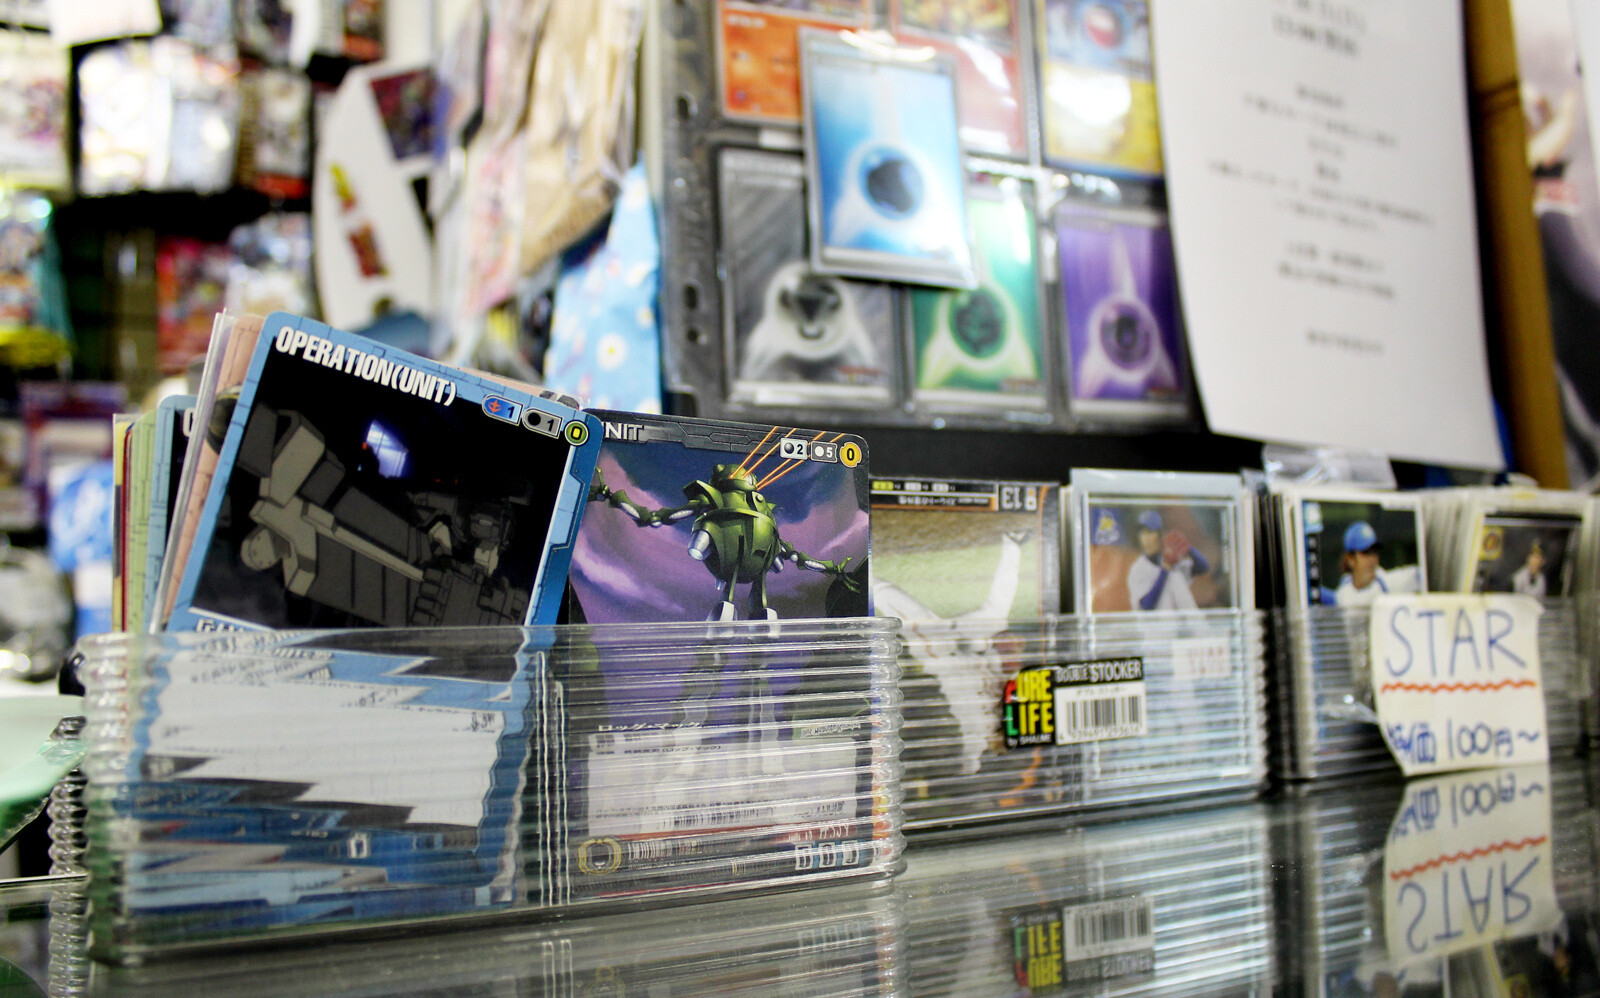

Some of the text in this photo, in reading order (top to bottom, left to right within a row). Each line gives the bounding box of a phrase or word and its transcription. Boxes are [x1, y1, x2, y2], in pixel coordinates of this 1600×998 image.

[275, 325, 457, 407] OPERATION(UNIT)
[506, 405, 515, 419] 1
[546, 418, 555, 432] 1
[603, 421, 645, 442] NIT
[796, 443, 804, 455] 2
[826, 446, 833, 458] 5
[847, 448, 854, 462] 0
[1385, 605, 1527, 677] STAR
[1089, 660, 1143, 682] STOCKER
[1005, 702, 1054, 736] LIFE
